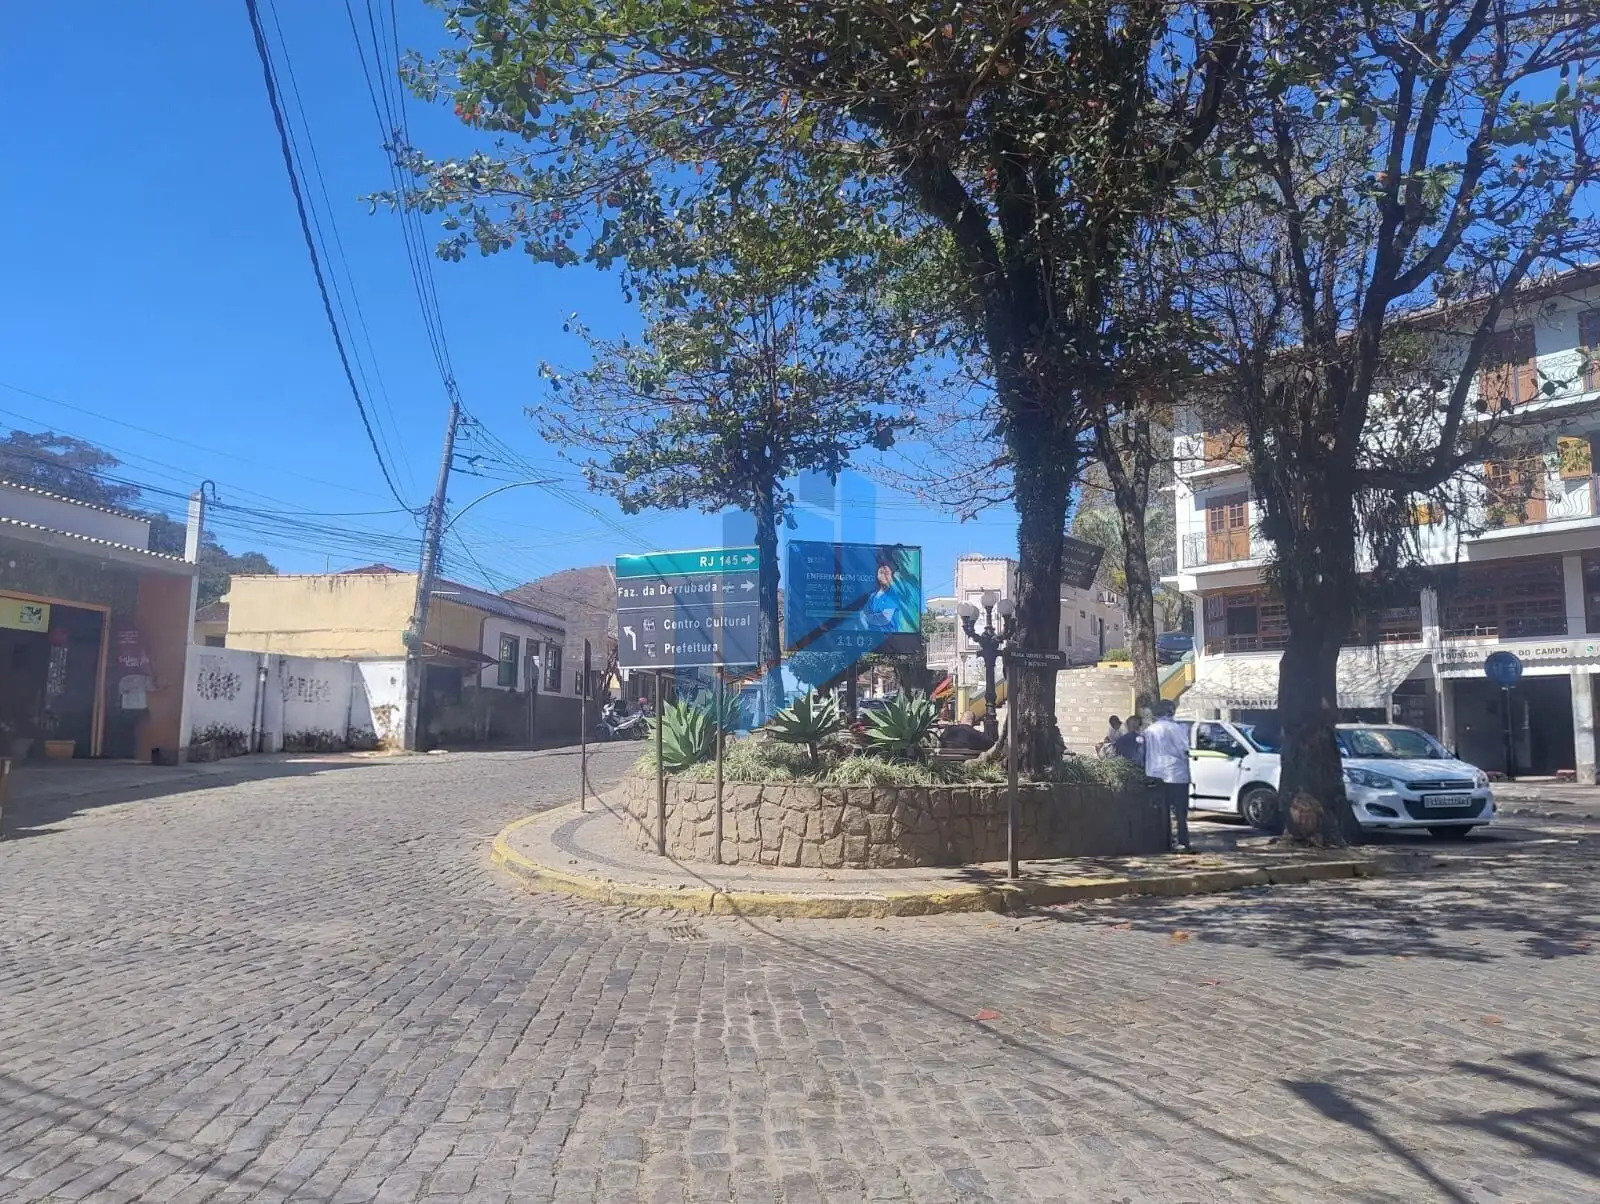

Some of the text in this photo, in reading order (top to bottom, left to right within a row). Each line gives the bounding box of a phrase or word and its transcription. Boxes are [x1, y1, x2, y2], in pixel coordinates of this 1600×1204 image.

[699, 555, 738, 567] RJ 145
[618, 582, 718, 598] Faz. da Derrubada
[663, 615, 751, 630] Centro Cultural
[664, 642, 718, 655] Prefeitura
[1440, 651, 1479, 660] POUSADA
[1518, 649, 1531, 657] DO
[1535, 647, 1568, 656] CAMPO
